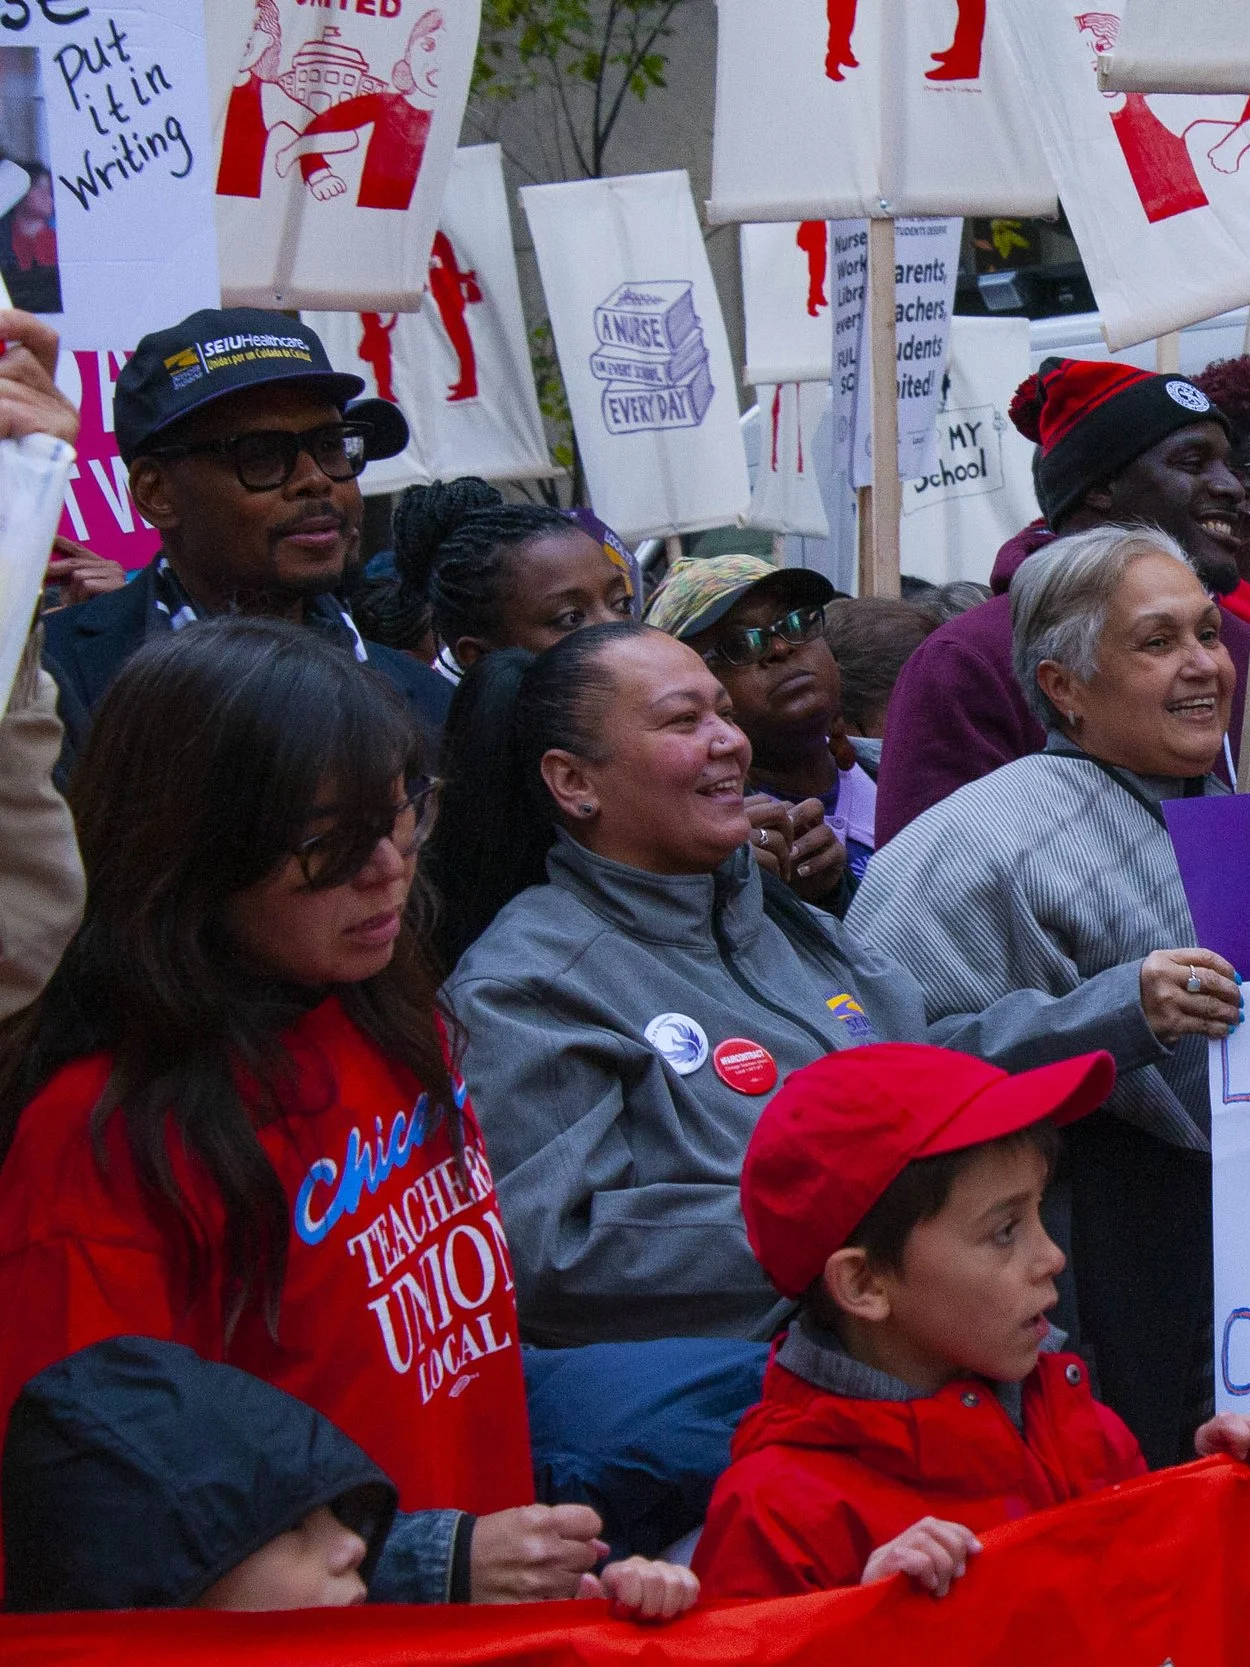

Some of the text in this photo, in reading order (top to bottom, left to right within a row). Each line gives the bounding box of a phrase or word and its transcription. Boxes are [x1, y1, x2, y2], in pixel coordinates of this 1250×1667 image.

[53, 18, 131, 111] Put
[85, 64, 173, 135] it in
[58, 115, 193, 211] Writing
[895, 257, 947, 285] arents,
[602, 313, 665, 349] A NURSE
[895, 296, 946, 323] achers,
[949, 421, 982, 451] MY
[367, 1210, 515, 1374] UNION
[417, 1312, 512, 1405] LOCAL
